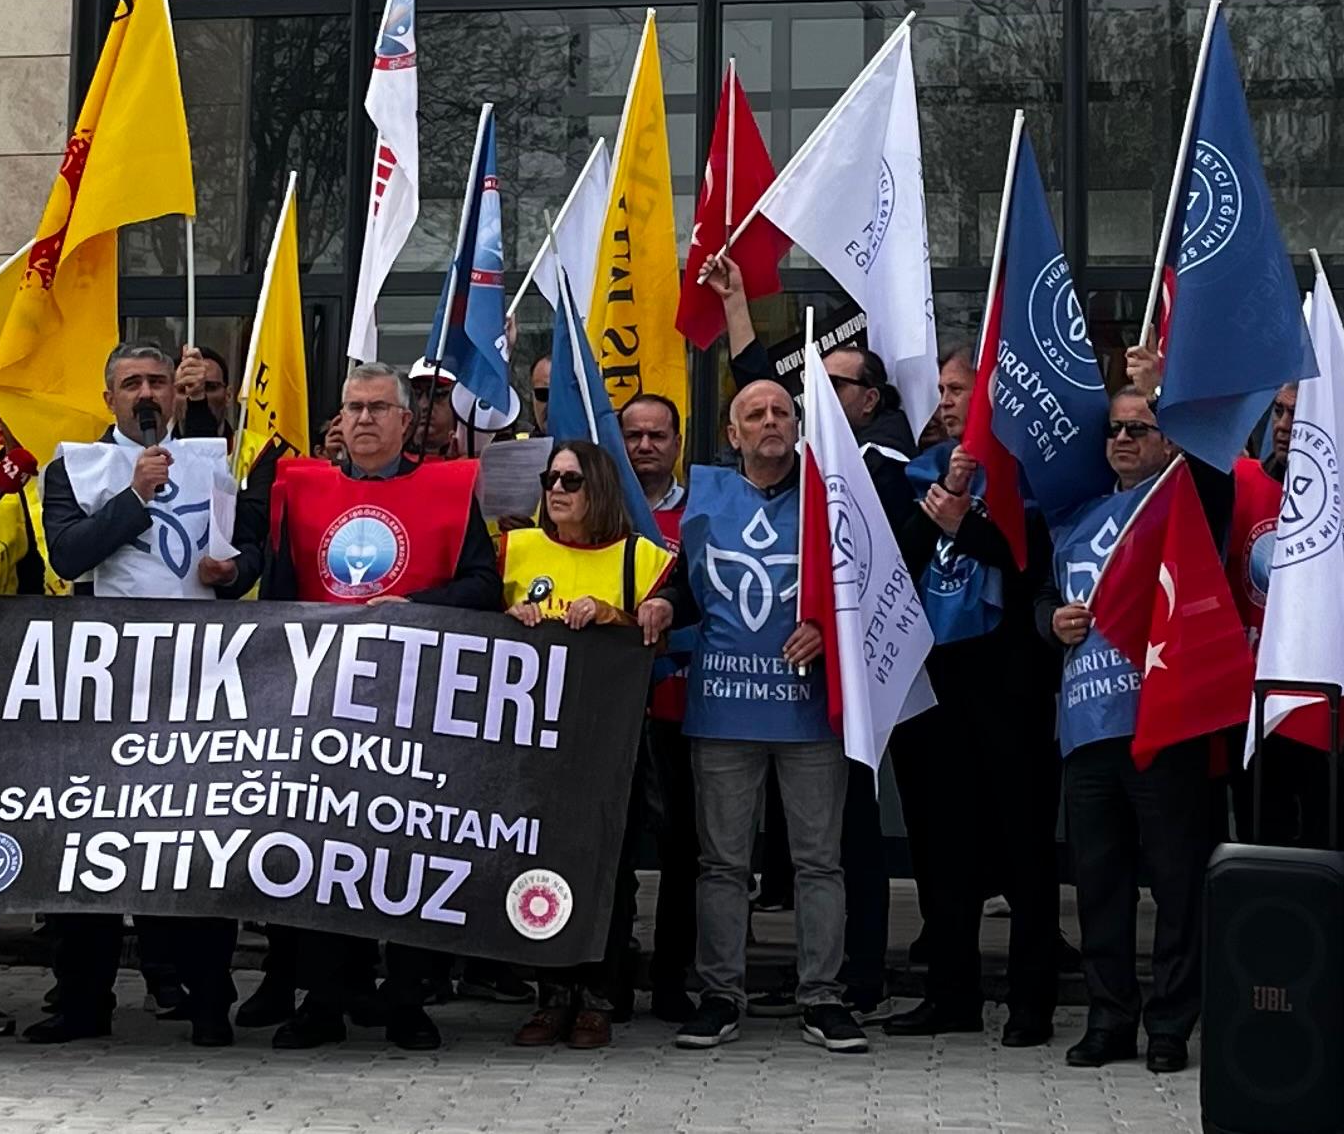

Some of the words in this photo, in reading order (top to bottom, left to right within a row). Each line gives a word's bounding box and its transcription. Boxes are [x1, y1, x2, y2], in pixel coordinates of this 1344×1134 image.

[1042, 337, 1069, 372] 2021
[996, 379, 1025, 417] TİM
[1027, 419, 1057, 462] SEN
[997, 340, 1080, 444] ÜRRİYETÇİ
[1284, 537, 1317, 558] SEN
[2, 621, 258, 723] ARTIK
[284, 621, 569, 750] YETER!
[702, 678, 812, 702] EĞİTİM-SEN
[111, 727, 302, 767] GÜVENLİ
[310, 727, 450, 790] OKUL,
[204, 770, 361, 827] EĞİTİM
[367, 795, 541, 855] ORTAMI
[56, 829, 473, 926] İSTİYORUZ
[1253, 985, 1293, 1012] JBL
